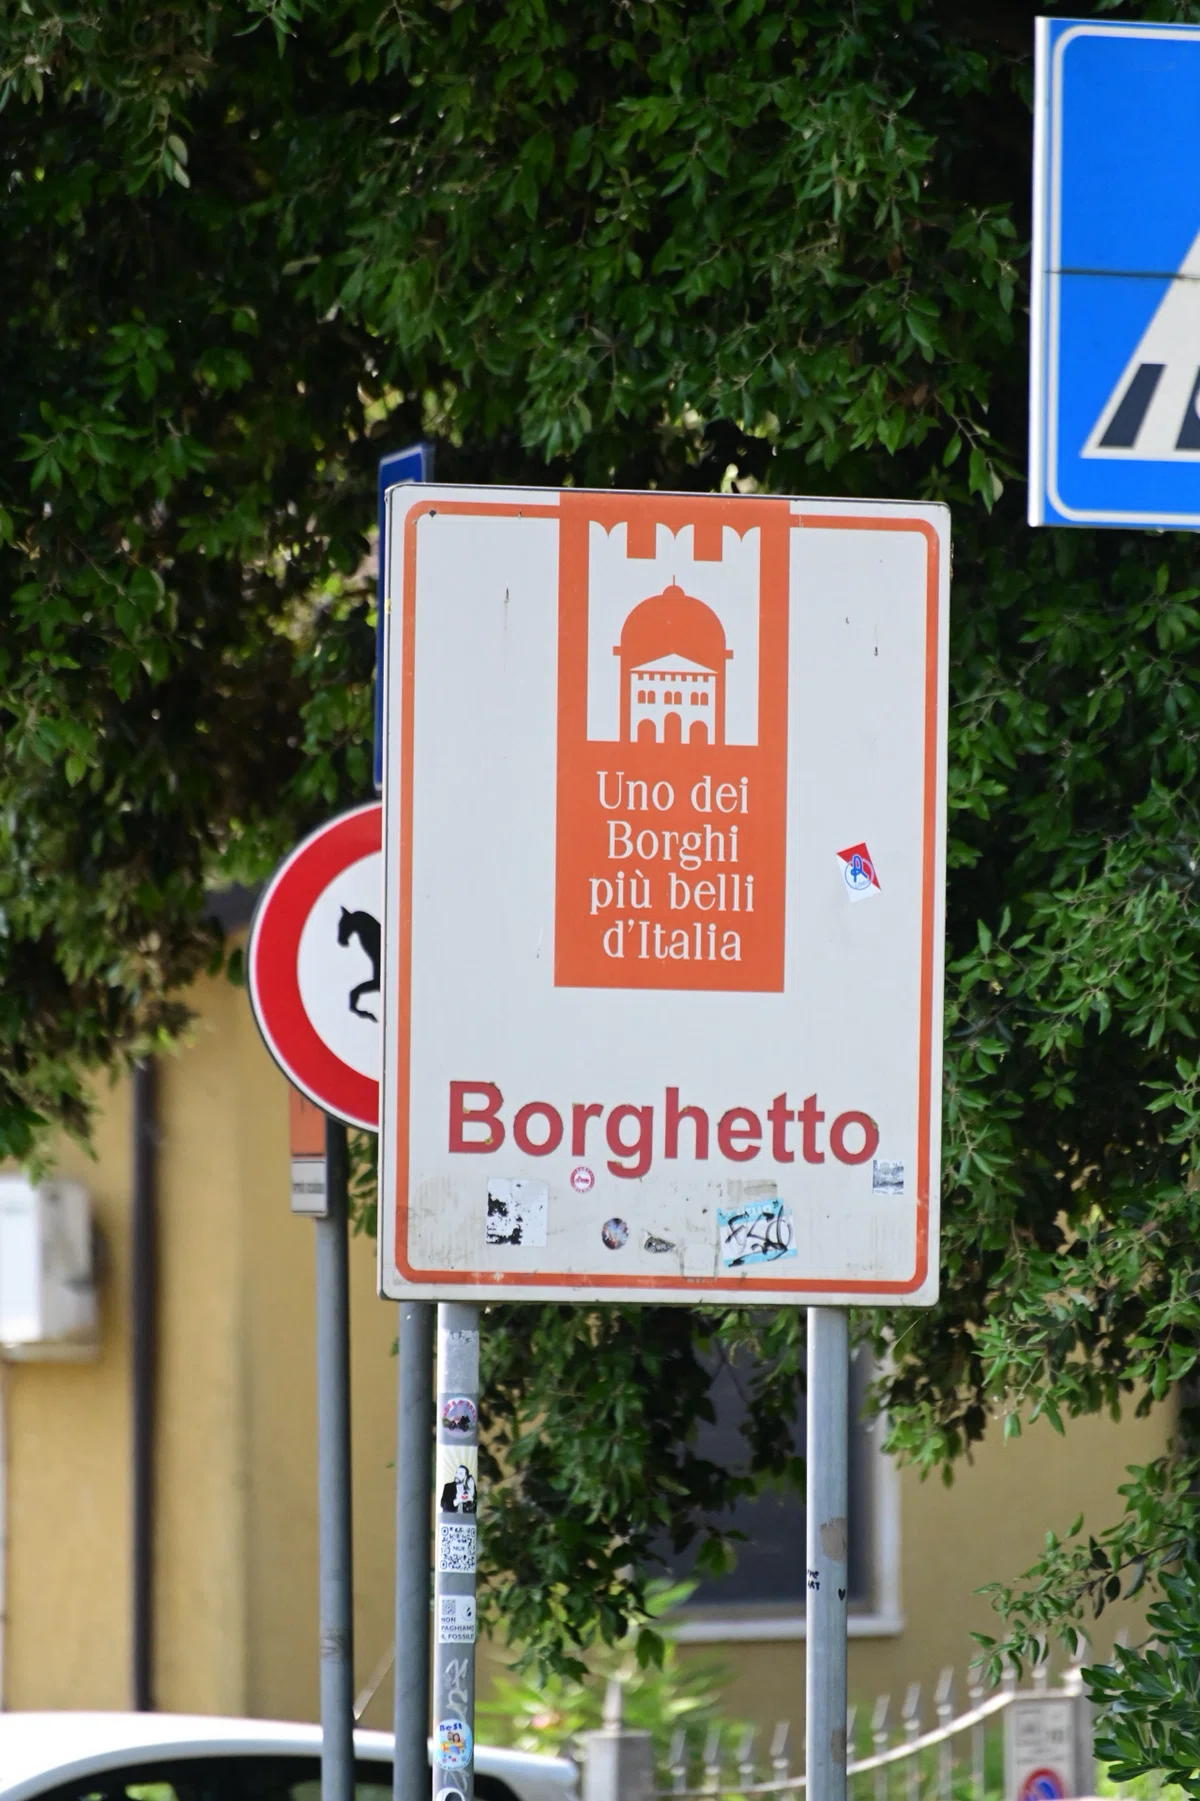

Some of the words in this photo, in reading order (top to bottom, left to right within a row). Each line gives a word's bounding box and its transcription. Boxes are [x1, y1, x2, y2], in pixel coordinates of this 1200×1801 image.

[596, 770, 675, 811] Uno
[690, 775, 749, 813] dei
[606, 820, 739, 871] Borghi
[589, 869, 652, 915] più
[668, 872, 754, 912] belli
[603, 919, 742, 961] d'Italia
[448, 1080, 880, 1179] Borghetto
[439, 1722, 463, 1732] Best
